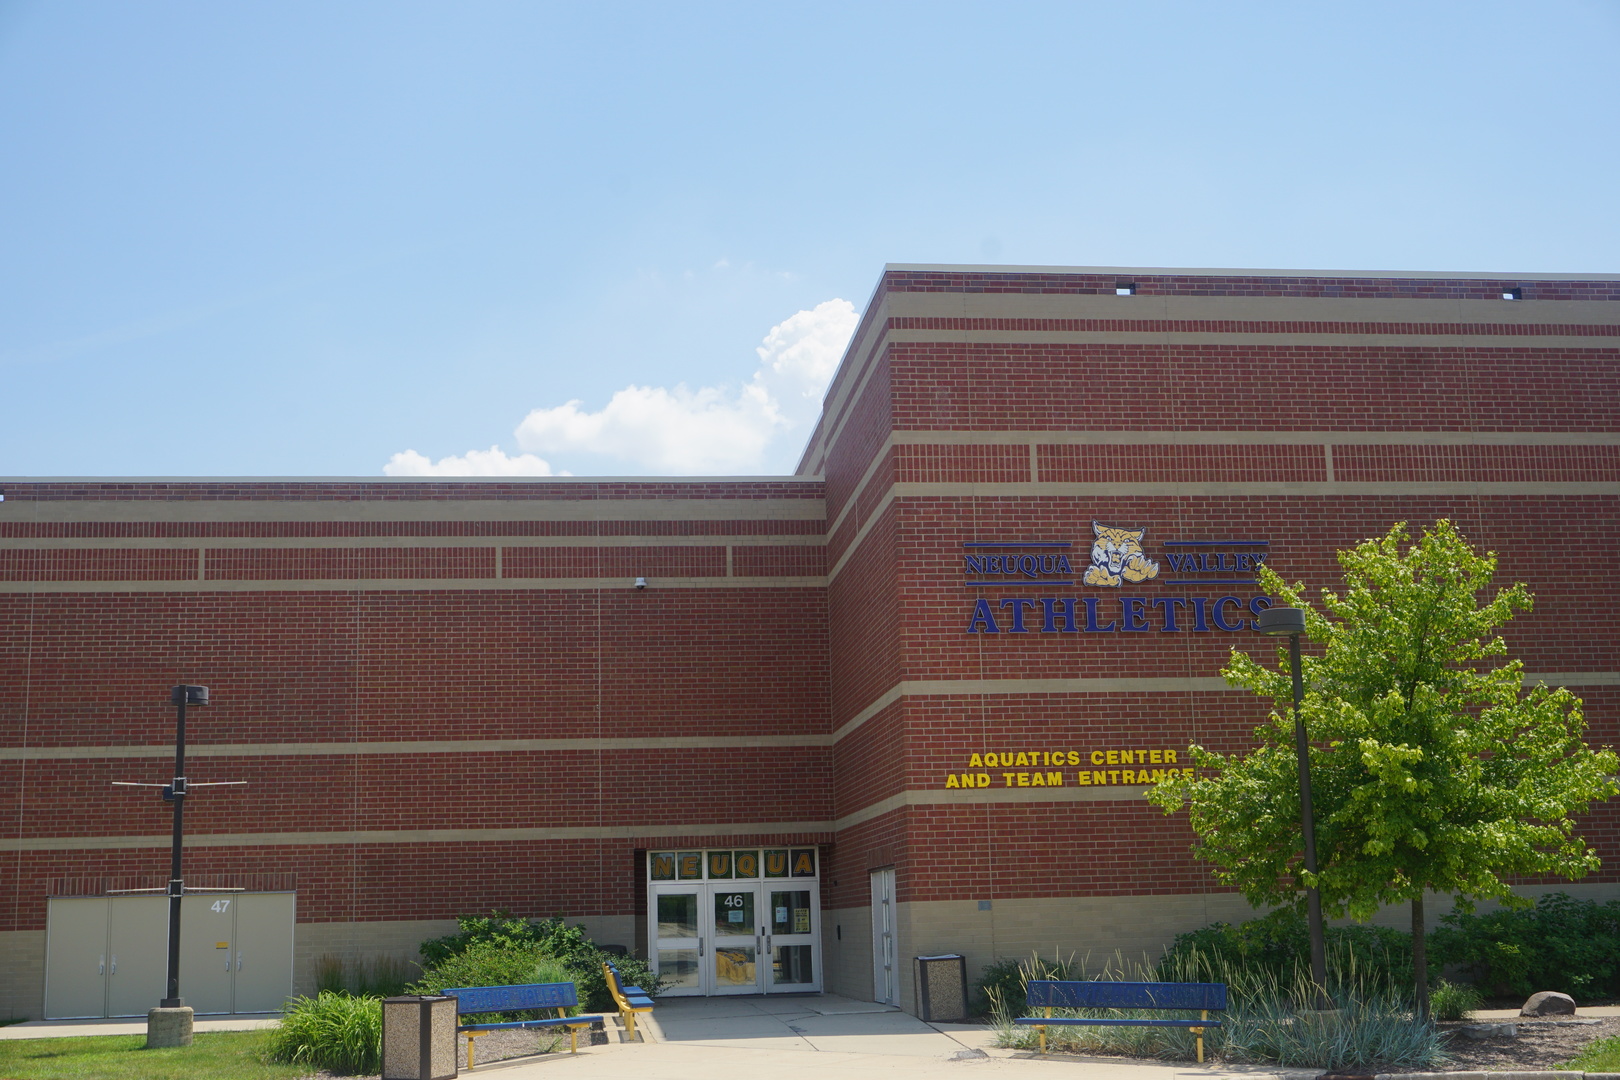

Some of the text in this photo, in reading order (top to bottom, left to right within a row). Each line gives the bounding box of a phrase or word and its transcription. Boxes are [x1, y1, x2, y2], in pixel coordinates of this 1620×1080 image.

[964, 553, 1268, 578] NEUQUA VALLEY
[966, 596, 1273, 634] ATHLETICS
[969, 749, 1177, 768] AQUATICS CENTER
[946, 768, 1195, 789] AND TEAM ENTRANCE
[653, 853, 814, 877] NEUQUA
[211, 900, 230, 913] 47
[724, 895, 743, 908] 46
